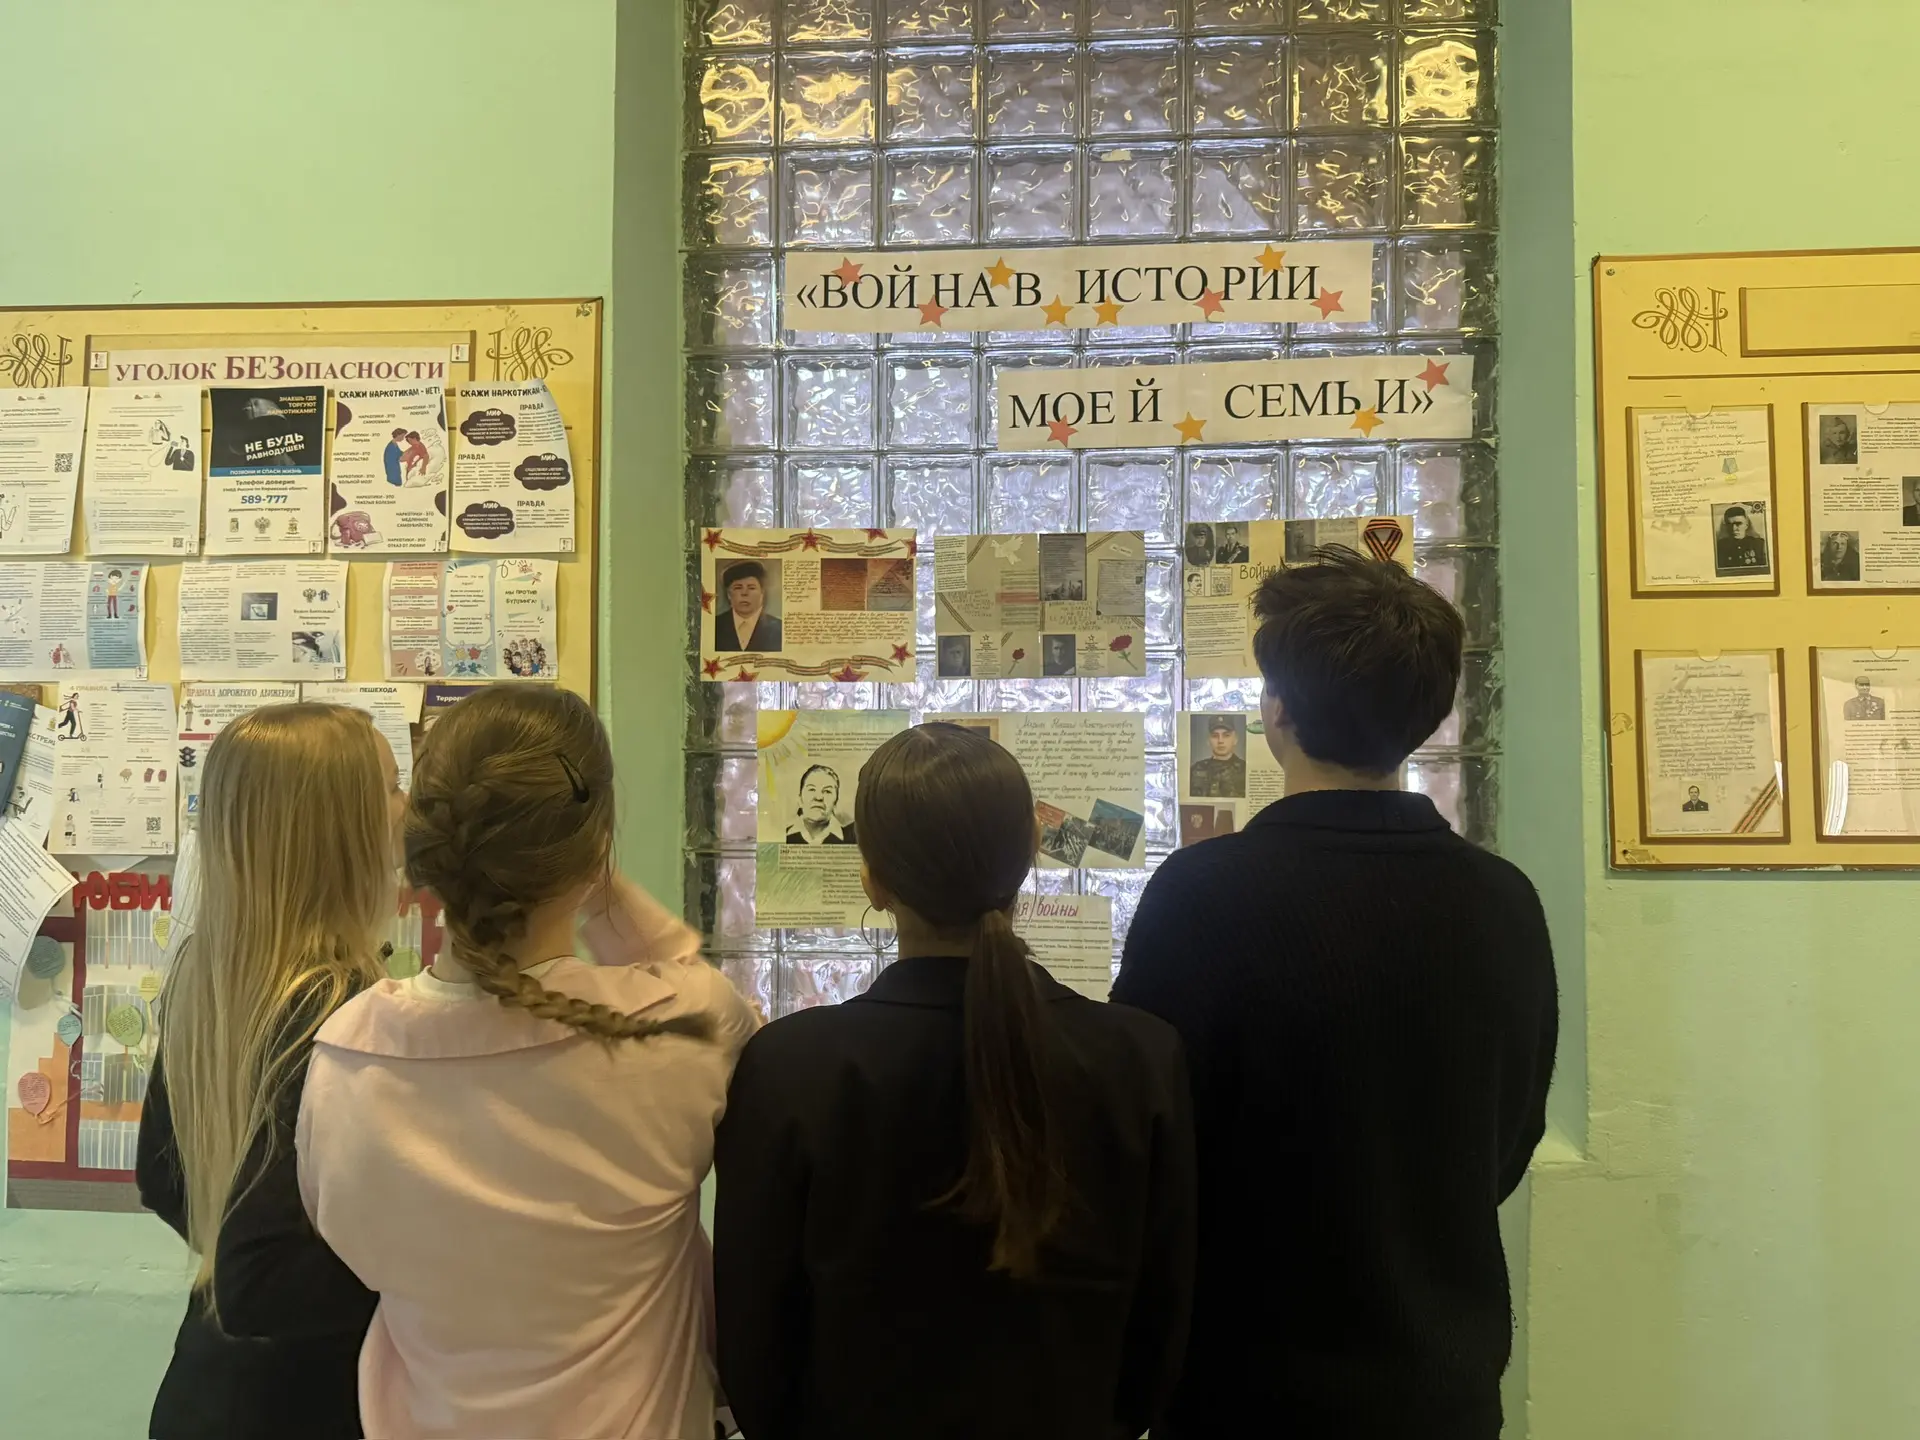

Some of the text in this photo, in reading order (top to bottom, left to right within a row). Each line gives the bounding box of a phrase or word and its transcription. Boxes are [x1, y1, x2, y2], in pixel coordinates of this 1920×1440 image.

[796, 264, 1320, 310] «ВОЙНА В ИСТОРИИ
[116, 361, 217, 382] УГОЛОК
[339, 390, 368, 398] СКАЖИ
[369, 388, 420, 398] НАРКОТИКАМ
[425, 386, 441, 395] НЕТ!
[460, 389, 490, 397] СКАЖИ
[520, 402, 544, 410] ПРАВДА
[1008, 377, 1435, 429] МОЕЙ СЕМЬИ»
[244, 432, 304, 453] НЕ БУДЬ
[246, 444, 305, 461] РАВНОДУШЕН
[241, 495, 288, 504] 589-777
[71, 870, 172, 912] ЮБИ
